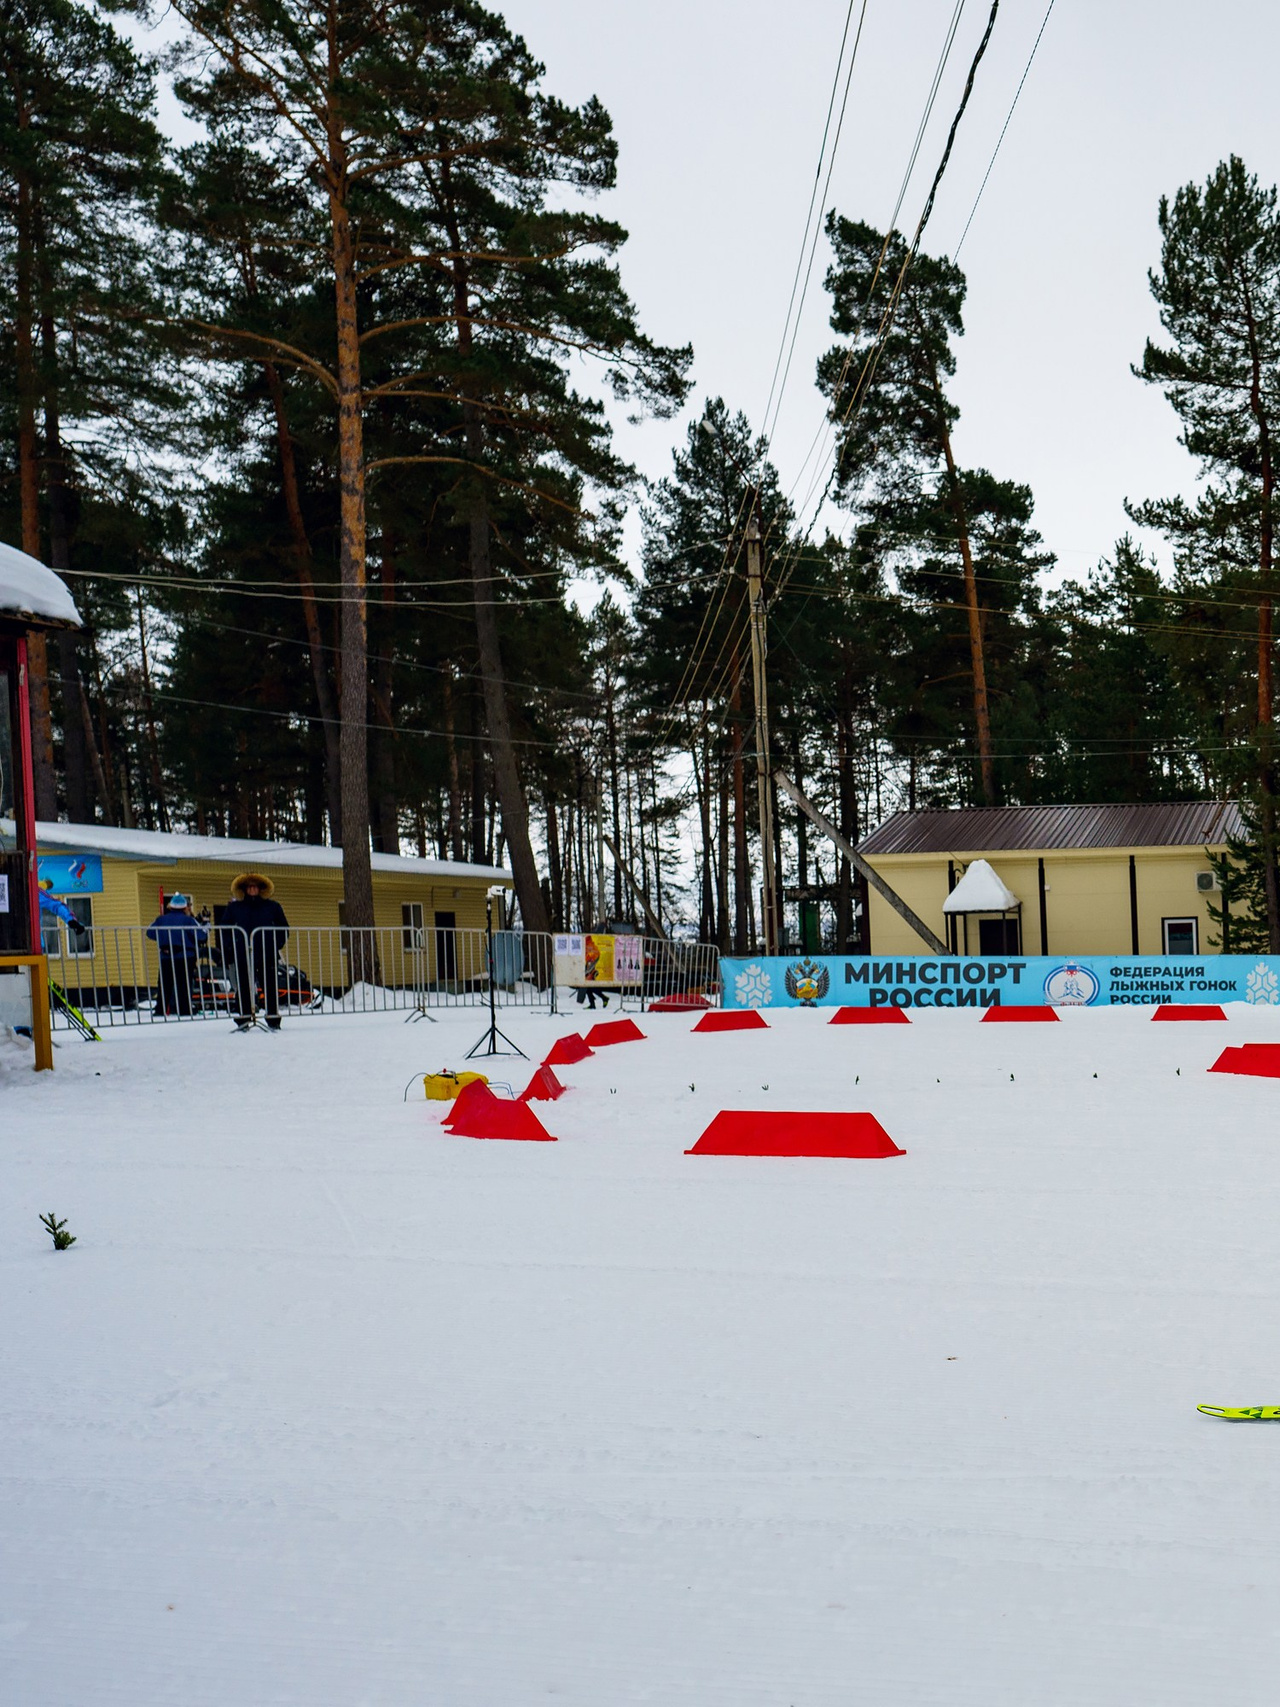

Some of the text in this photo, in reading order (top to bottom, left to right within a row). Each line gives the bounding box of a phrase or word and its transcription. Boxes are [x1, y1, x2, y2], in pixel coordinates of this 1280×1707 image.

[845, 962, 1027, 984] МИНСПОРТ
[1109, 966, 1205, 979] ФЕДЕРАЦИЯ
[1109, 980, 1237, 992] ЛЫЖНЫХ ГОНОК
[869, 987, 1001, 1008] РОССИИ
[1110, 994, 1172, 1005] РОССИИ
